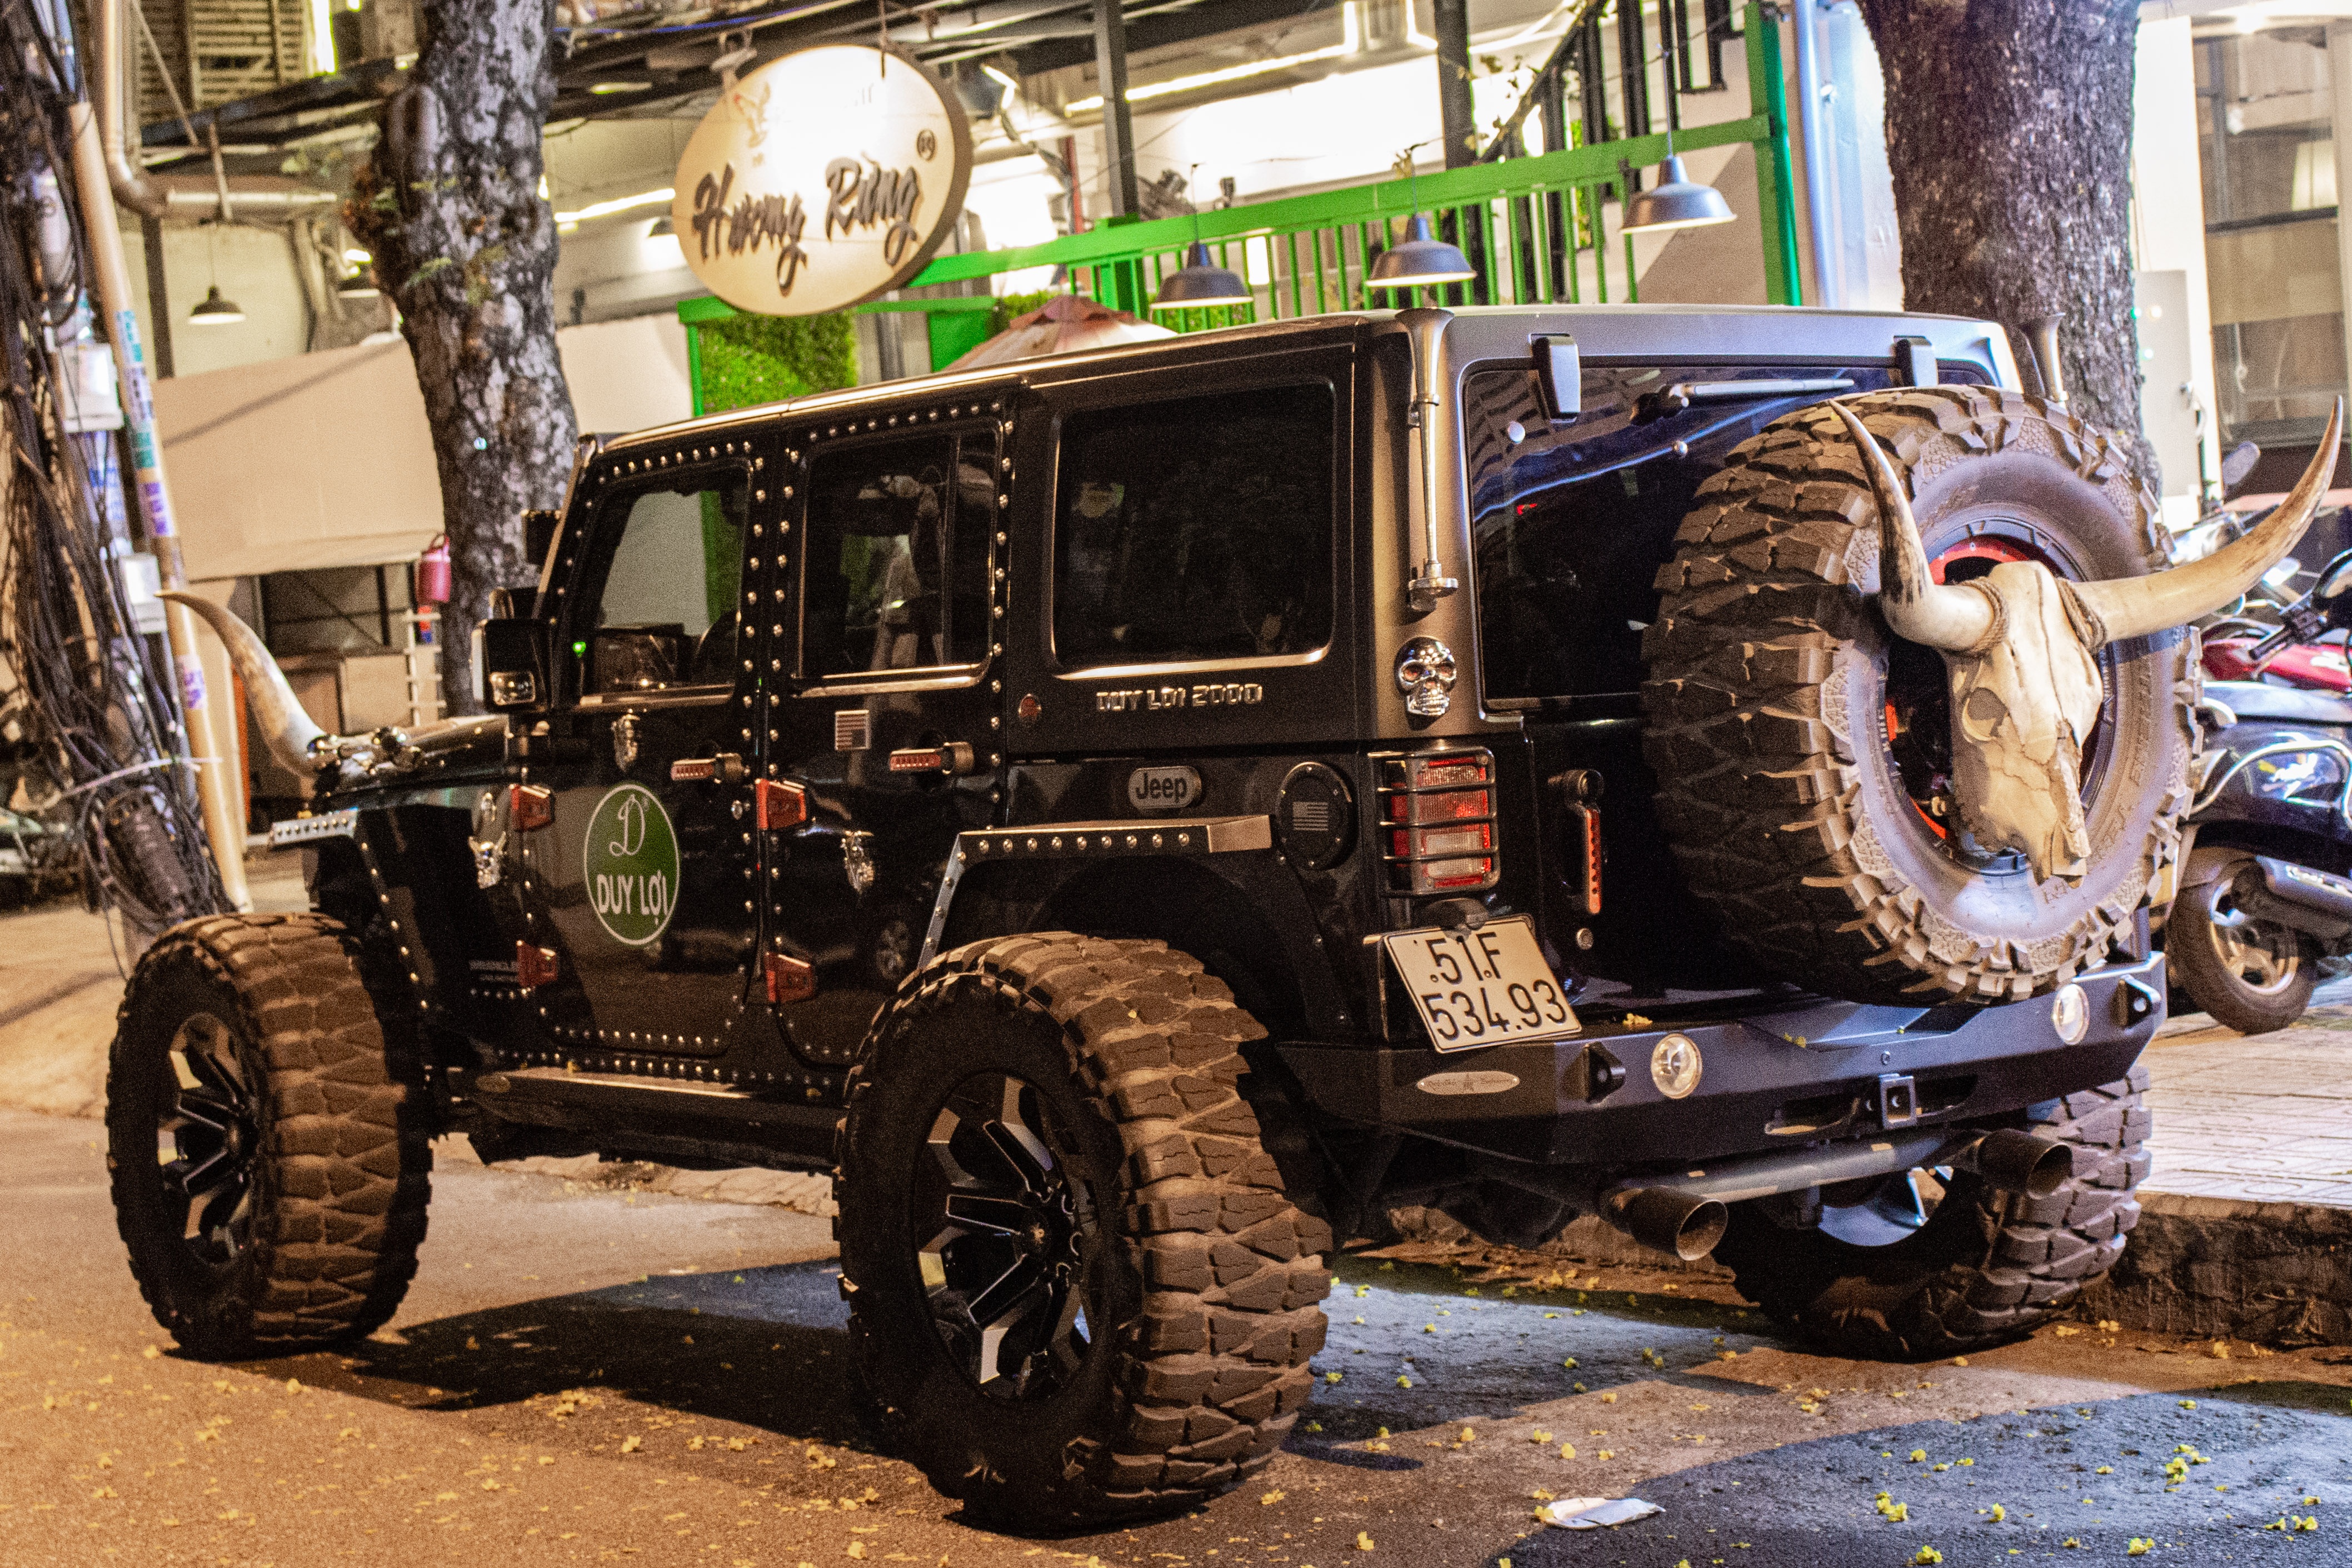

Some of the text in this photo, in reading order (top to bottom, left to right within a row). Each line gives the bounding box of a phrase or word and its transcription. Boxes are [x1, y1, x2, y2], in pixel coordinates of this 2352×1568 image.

[1096, 689, 1143, 711] DUY
[1192, 683, 1262, 707] 2000
[1135, 772, 1187, 802] Jeep
[596, 870, 668, 926] DUY LỢI
[1421, 979, 1567, 1041] 534.93
